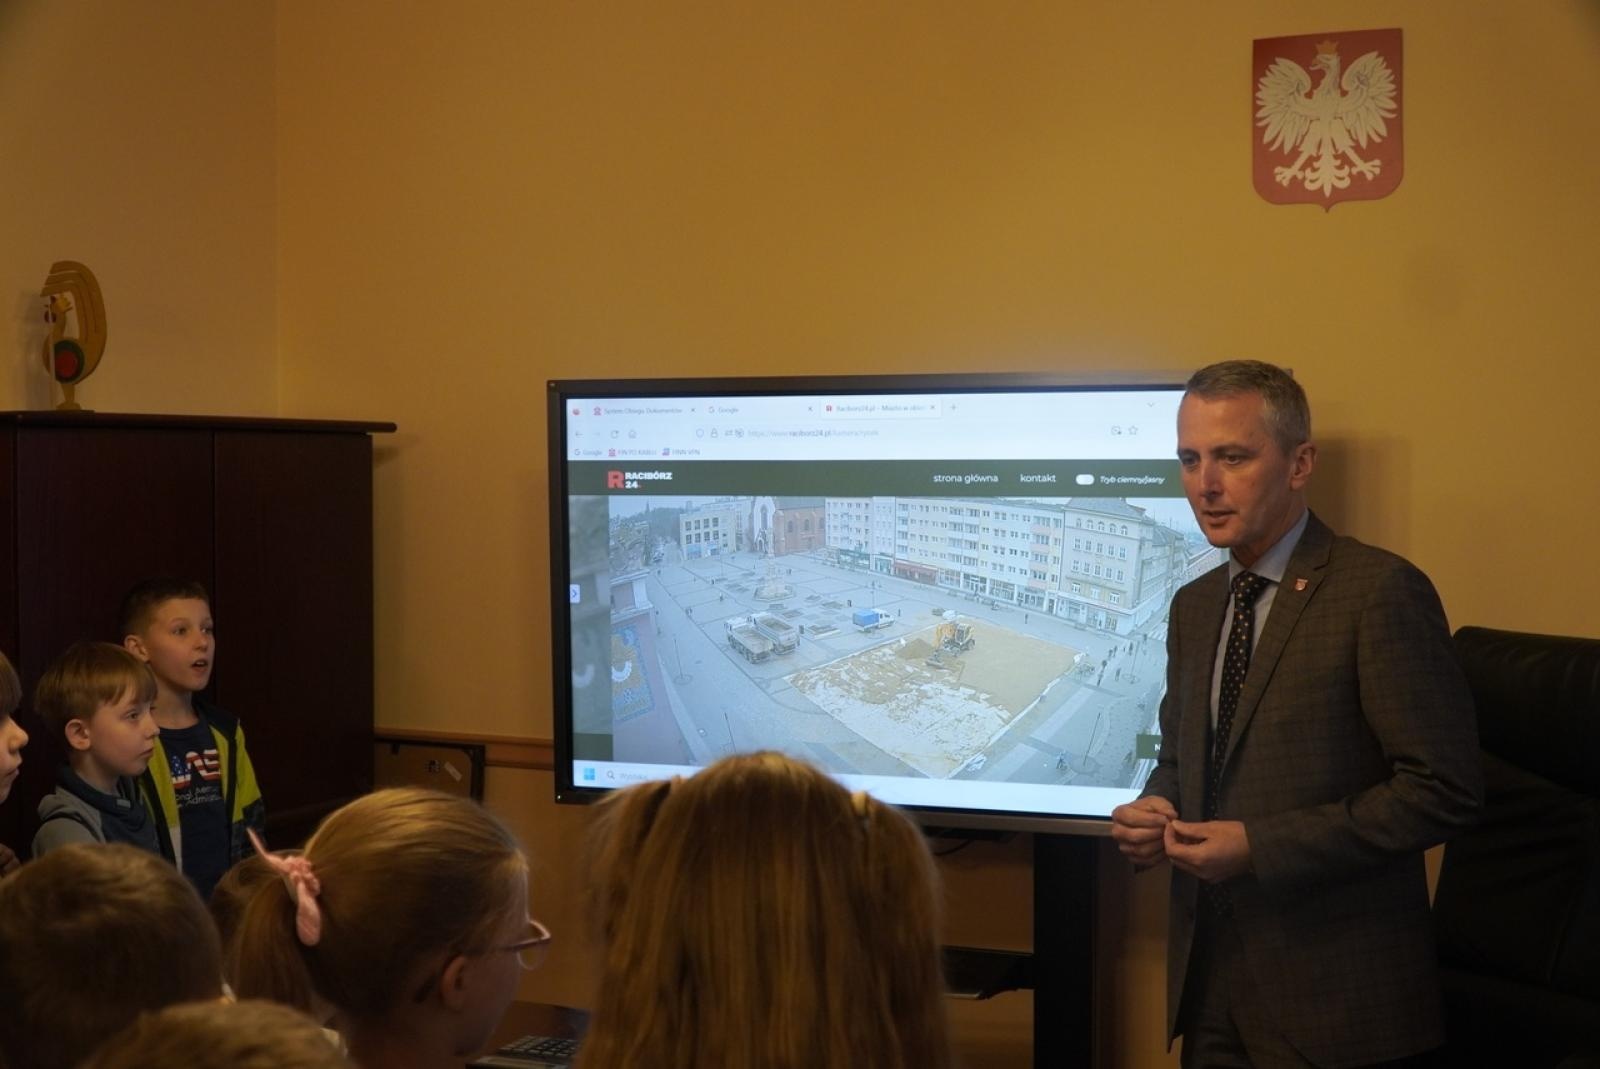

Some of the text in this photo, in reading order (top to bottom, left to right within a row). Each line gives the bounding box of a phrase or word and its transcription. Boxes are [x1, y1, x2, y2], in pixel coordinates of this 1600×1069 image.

[718, 406, 739, 415] Google
[608, 471, 624, 488] R
[625, 470, 673, 480] RACIBÓRZ
[933, 473, 999, 485] strona główna
[1020, 473, 1056, 483] kontakt
[1100, 475, 1116, 485] Tryb
